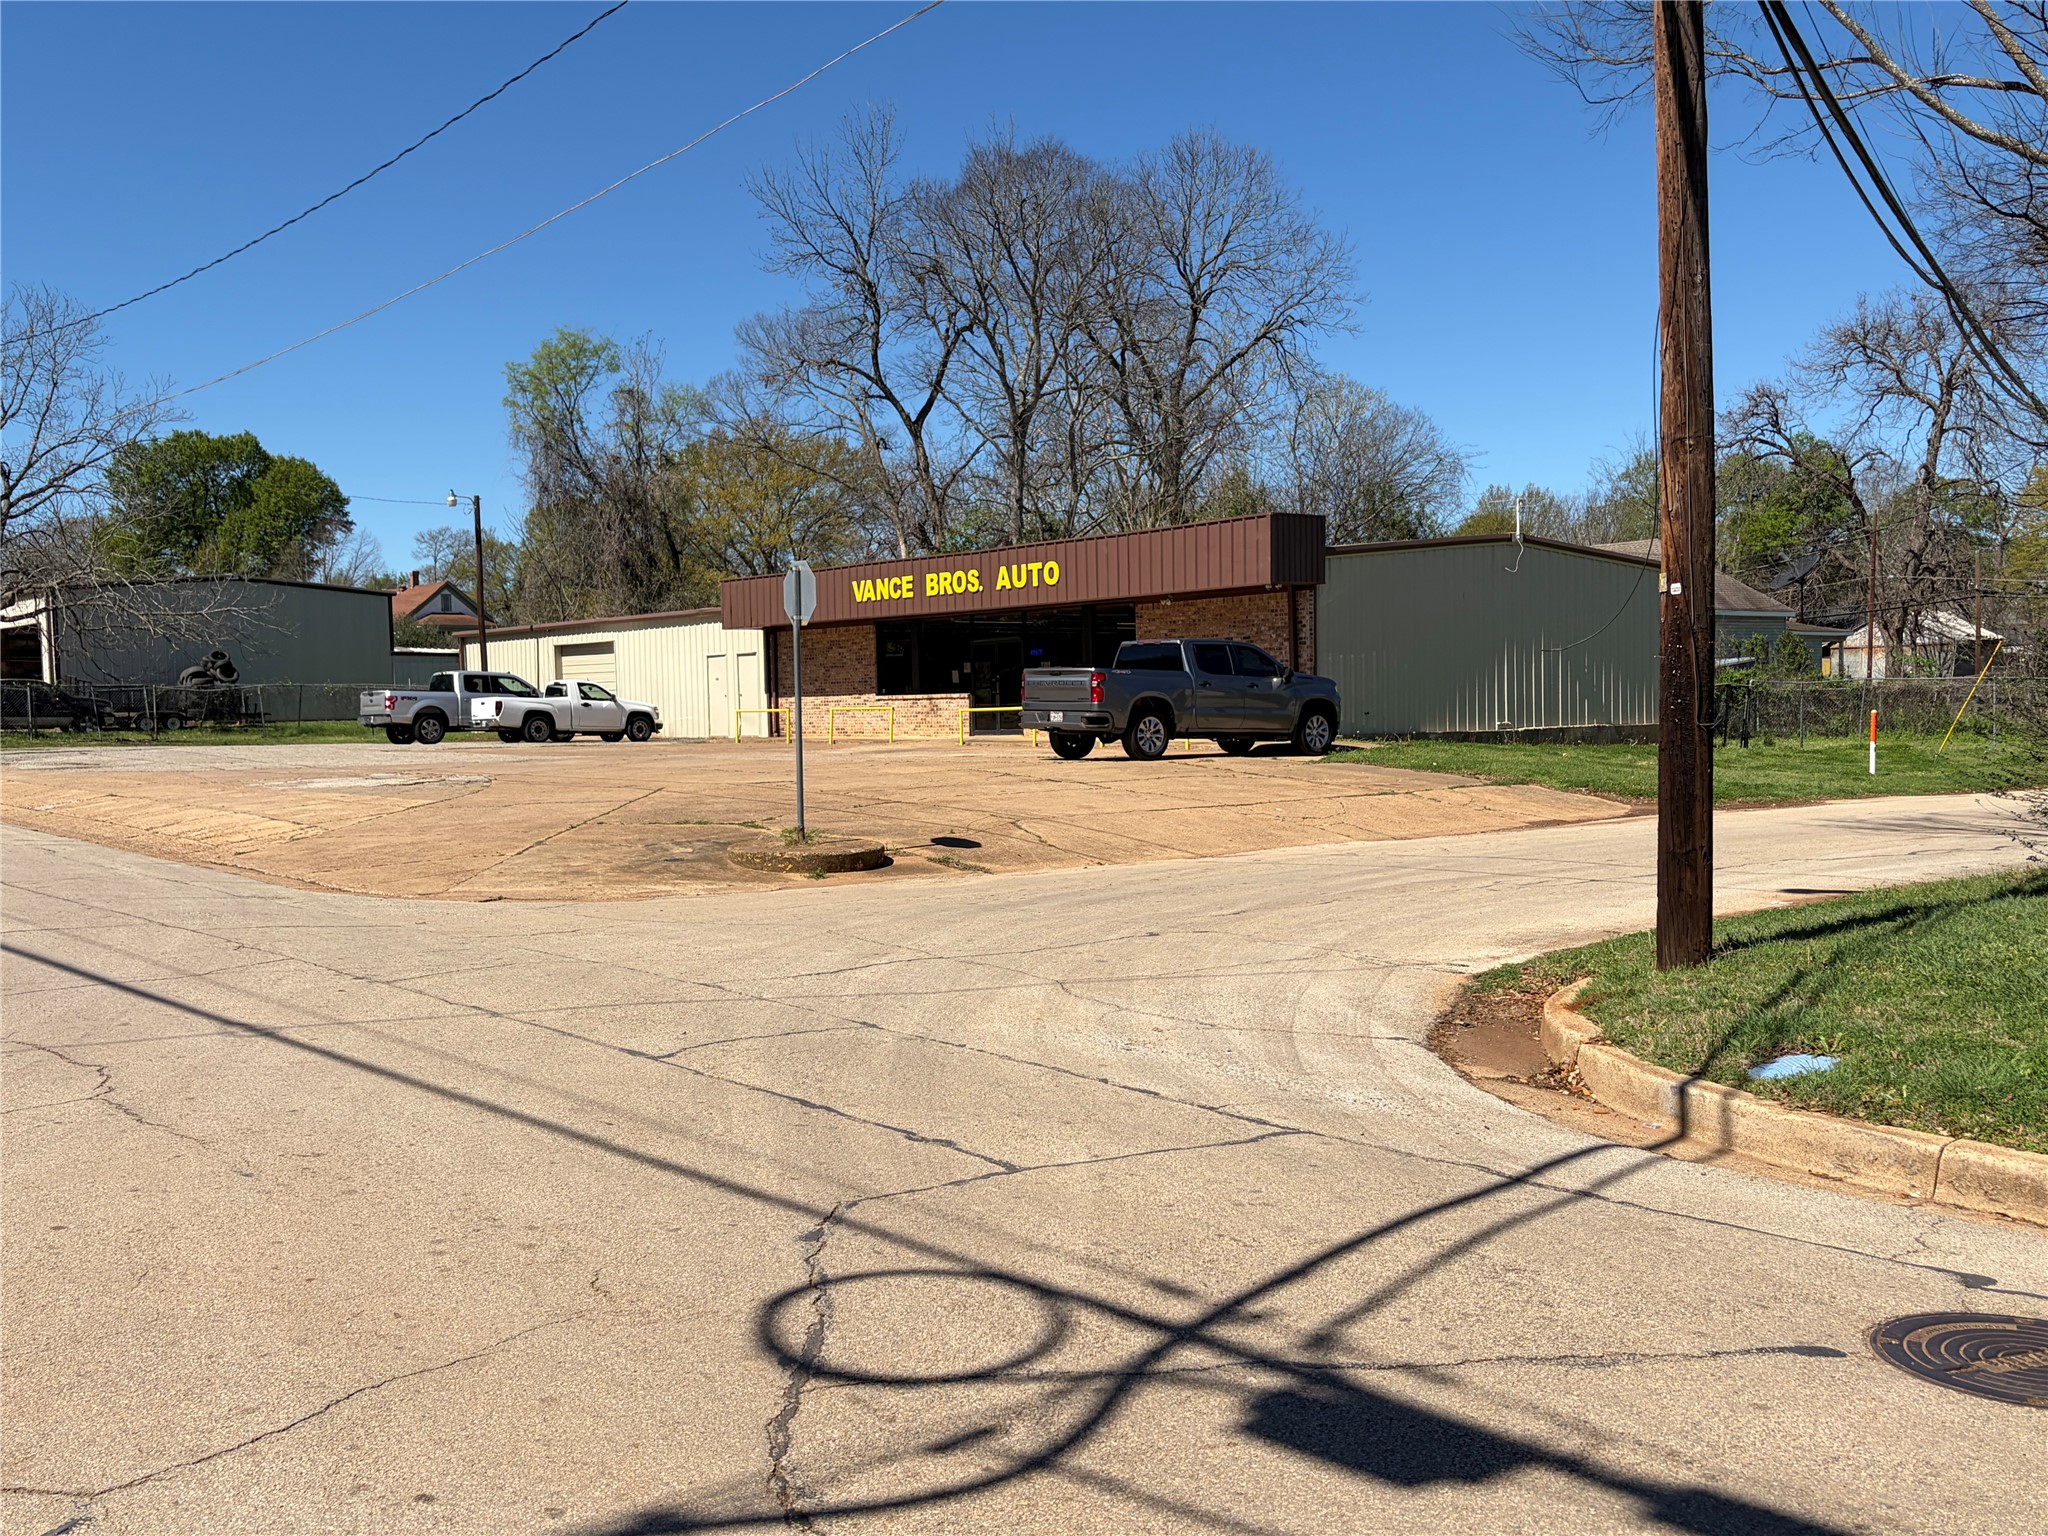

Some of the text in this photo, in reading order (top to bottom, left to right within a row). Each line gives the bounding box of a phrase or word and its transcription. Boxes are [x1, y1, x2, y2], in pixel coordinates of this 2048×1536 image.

[852, 561, 1060, 603] VANCE BROS. AUTO
